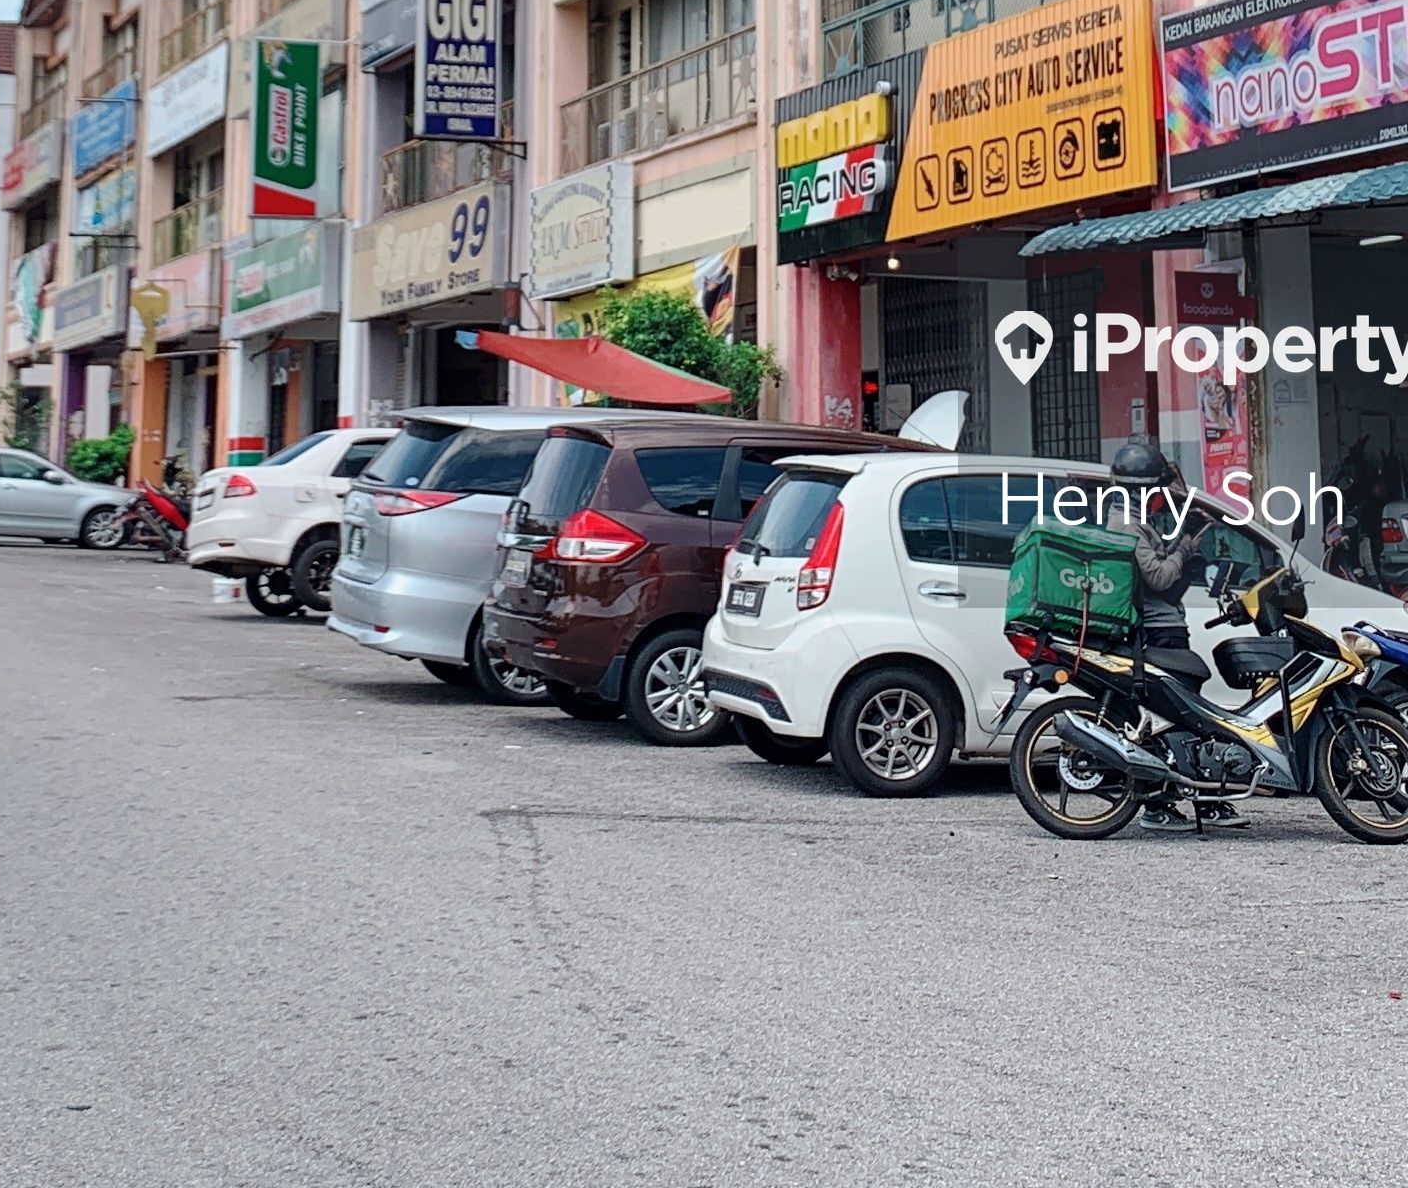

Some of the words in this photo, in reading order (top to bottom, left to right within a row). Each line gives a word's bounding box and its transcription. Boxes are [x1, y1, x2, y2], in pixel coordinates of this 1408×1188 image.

[994, 33, 1030, 60] PUSAT
[1031, 22, 1073, 48] SERVIS
[1075, 3, 1123, 35] KERETA
[1165, 24, 1192, 42] KEDAI
[1194, 5, 1244, 34] BARANGAN
[426, 63, 495, 84] PERMAI
[434, 43, 486, 63] ALAM
[929, 77, 991, 126] PROGRESS
[994, 64, 1024, 108] CITY
[1027, 55, 1061, 99] AUTO
[1066, 35, 1124, 88] SERVICE
[272, 90, 288, 145] Castrol
[294, 83, 308, 129] POINT
[779, 160, 878, 216] RACING
[448, 194, 490, 264] 99
[1183, 302, 1234, 317] foodpanda
